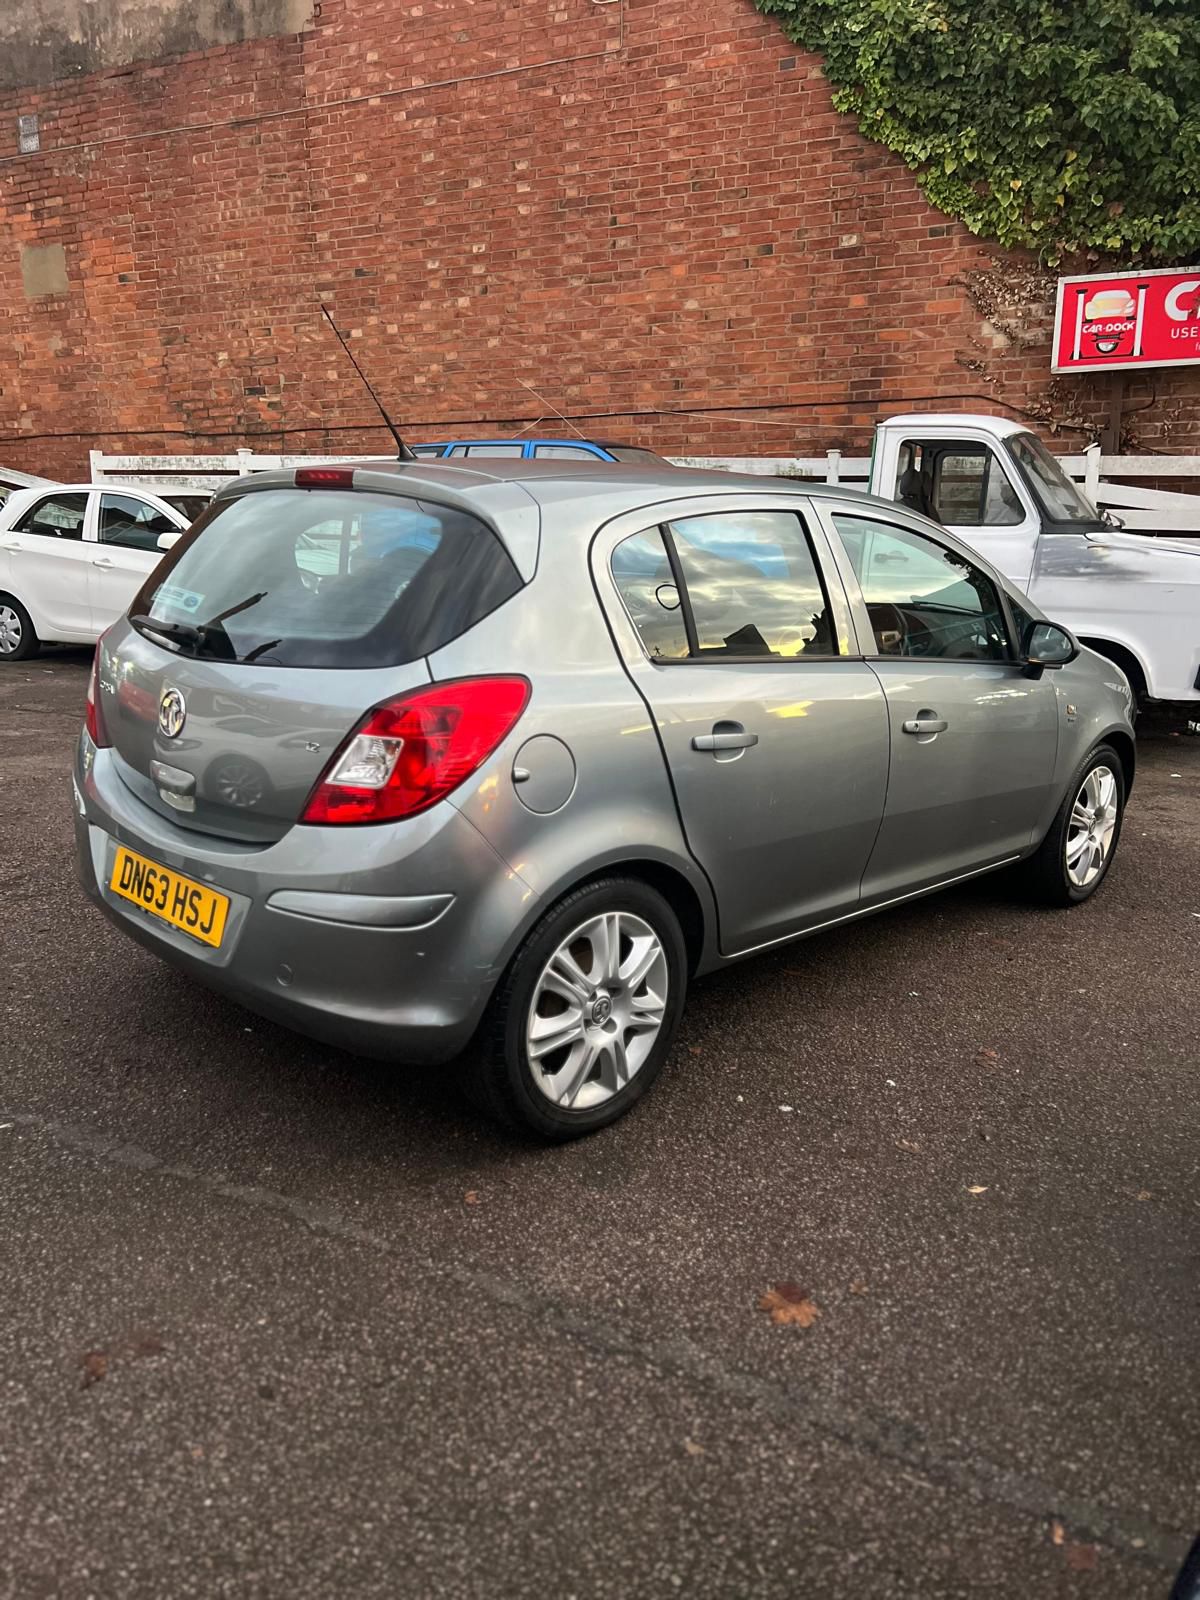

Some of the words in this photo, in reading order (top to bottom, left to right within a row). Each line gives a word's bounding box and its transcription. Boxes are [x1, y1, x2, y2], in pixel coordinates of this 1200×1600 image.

[1082, 321, 1136, 334] CAR-DOCK
[119, 854, 170, 911] DN63
[171, 881, 218, 935] HSJ
